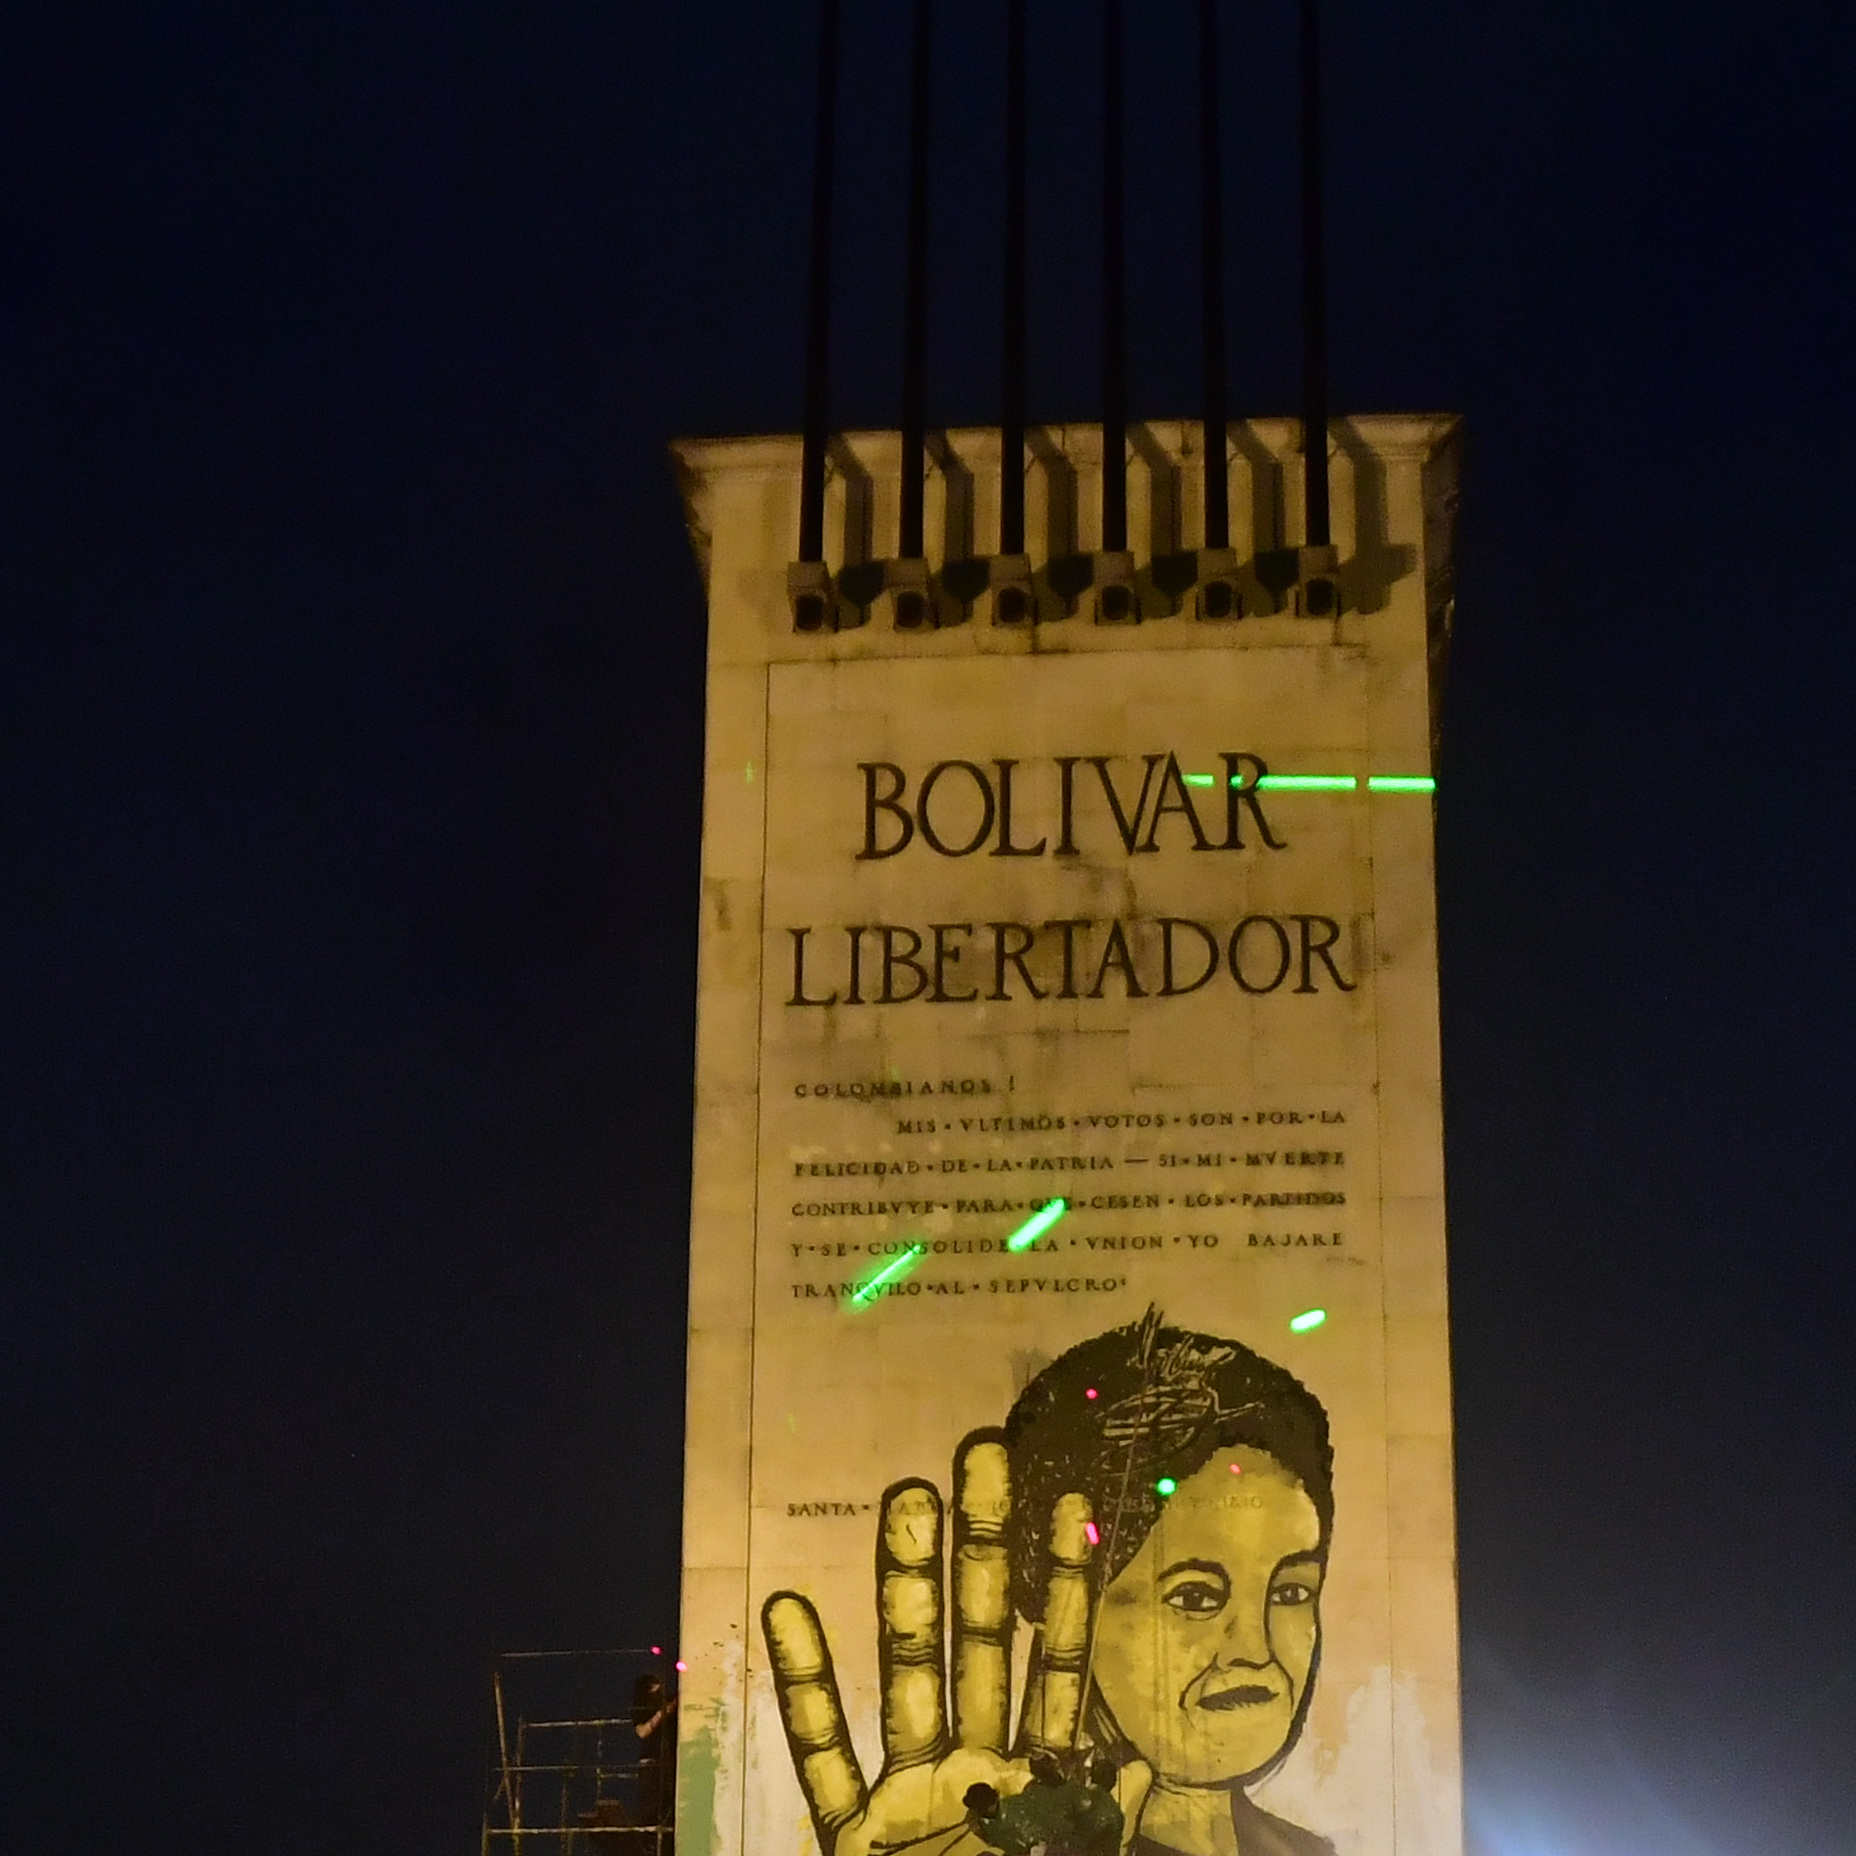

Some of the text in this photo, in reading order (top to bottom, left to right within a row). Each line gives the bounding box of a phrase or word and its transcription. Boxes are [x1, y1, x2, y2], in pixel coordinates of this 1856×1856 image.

[856, 751, 1287, 861] BOLIVAR
[786, 914, 1357, 1007] LIBERTADOR
[897, 1119, 937, 1134] MIS
[1088, 1114, 1165, 1129] VOTOS
[1189, 1112, 1233, 1126] SON
[1256, 1111, 1302, 1125] POR
[1321, 1110, 1345, 1124] LA
[794, 1159, 920, 1177] FELICIDAD
[942, 1158, 968, 1173] DE
[987, 1158, 1012, 1172] LA
[1029, 1155, 1113, 1171] PATRIA
[1159, 1153, 1176, 1167] SI
[1197, 1153, 1222, 1167] MI
[956, 1198, 1013, 1213] PARA
[1091, 1194, 1160, 1210] CESEN
[1184, 1194, 1224, 1208] LOS
[1242, 1191, 1346, 1209] PARTIDOS
[821, 1241, 847, 1257] SE
[1085, 1236, 1163, 1251] VNION
[1187, 1234, 1218, 1249] YO
[1248, 1232, 1342, 1248] BAJARE
[936, 1280, 965, 1295] AL
[787, 1502, 856, 1517] SANTA
